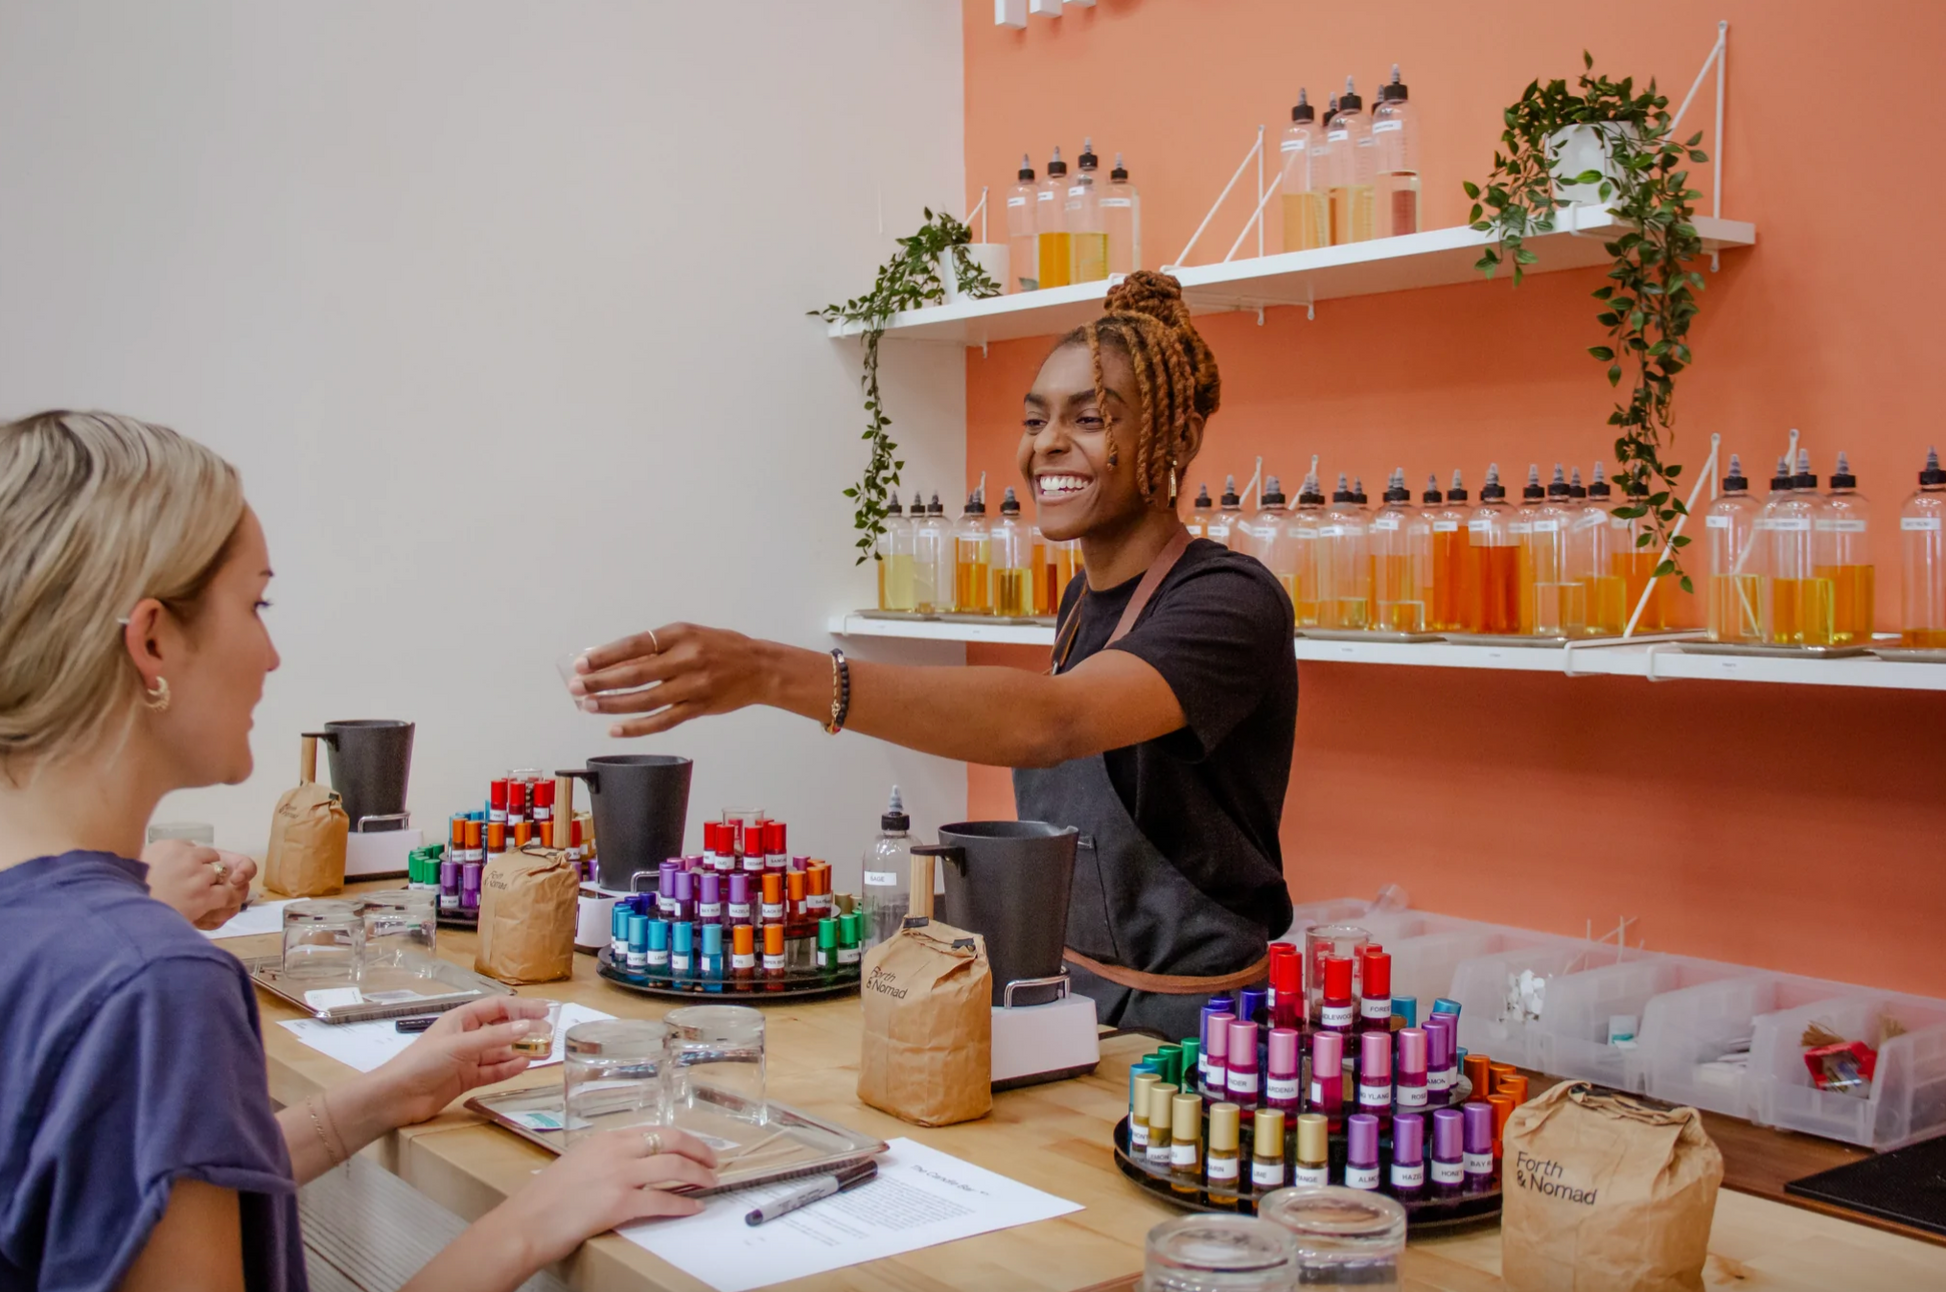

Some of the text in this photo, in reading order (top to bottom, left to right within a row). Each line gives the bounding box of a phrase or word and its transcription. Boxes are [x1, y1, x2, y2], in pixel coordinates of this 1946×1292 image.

[870, 875, 885, 883] SAGE
[870, 965, 896, 983] Forth
[872, 979, 909, 1000] Nomad
[1516, 1151, 1564, 1179] Forth
[1516, 1169, 1598, 1206] & Nomad
